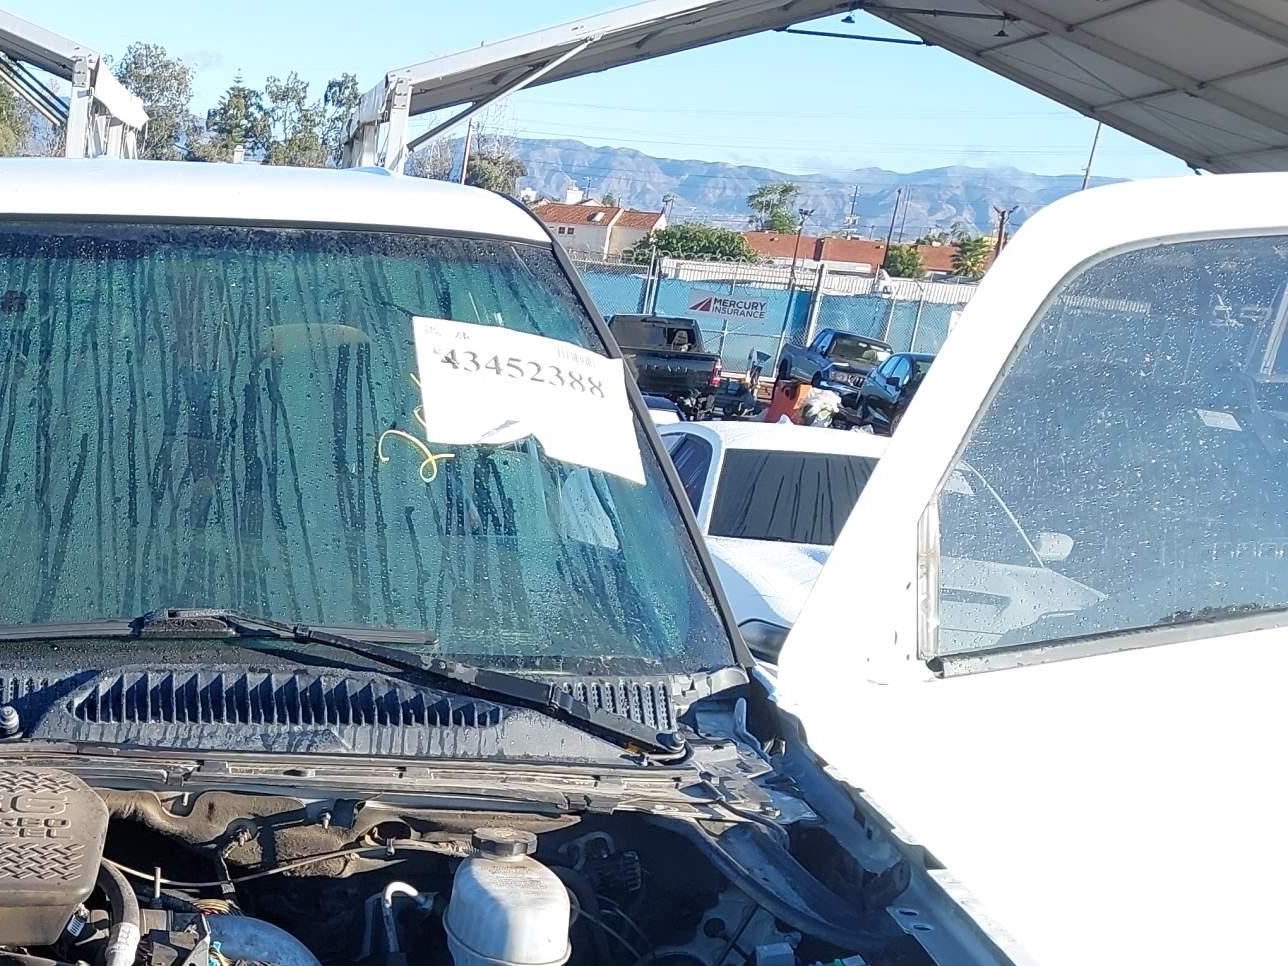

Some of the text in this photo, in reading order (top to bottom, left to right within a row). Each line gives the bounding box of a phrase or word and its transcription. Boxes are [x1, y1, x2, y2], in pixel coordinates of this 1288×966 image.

[713, 297, 768, 311] MERCURY
[711, 306, 766, 319] INSURANCE
[440, 347, 606, 399] 43452388
